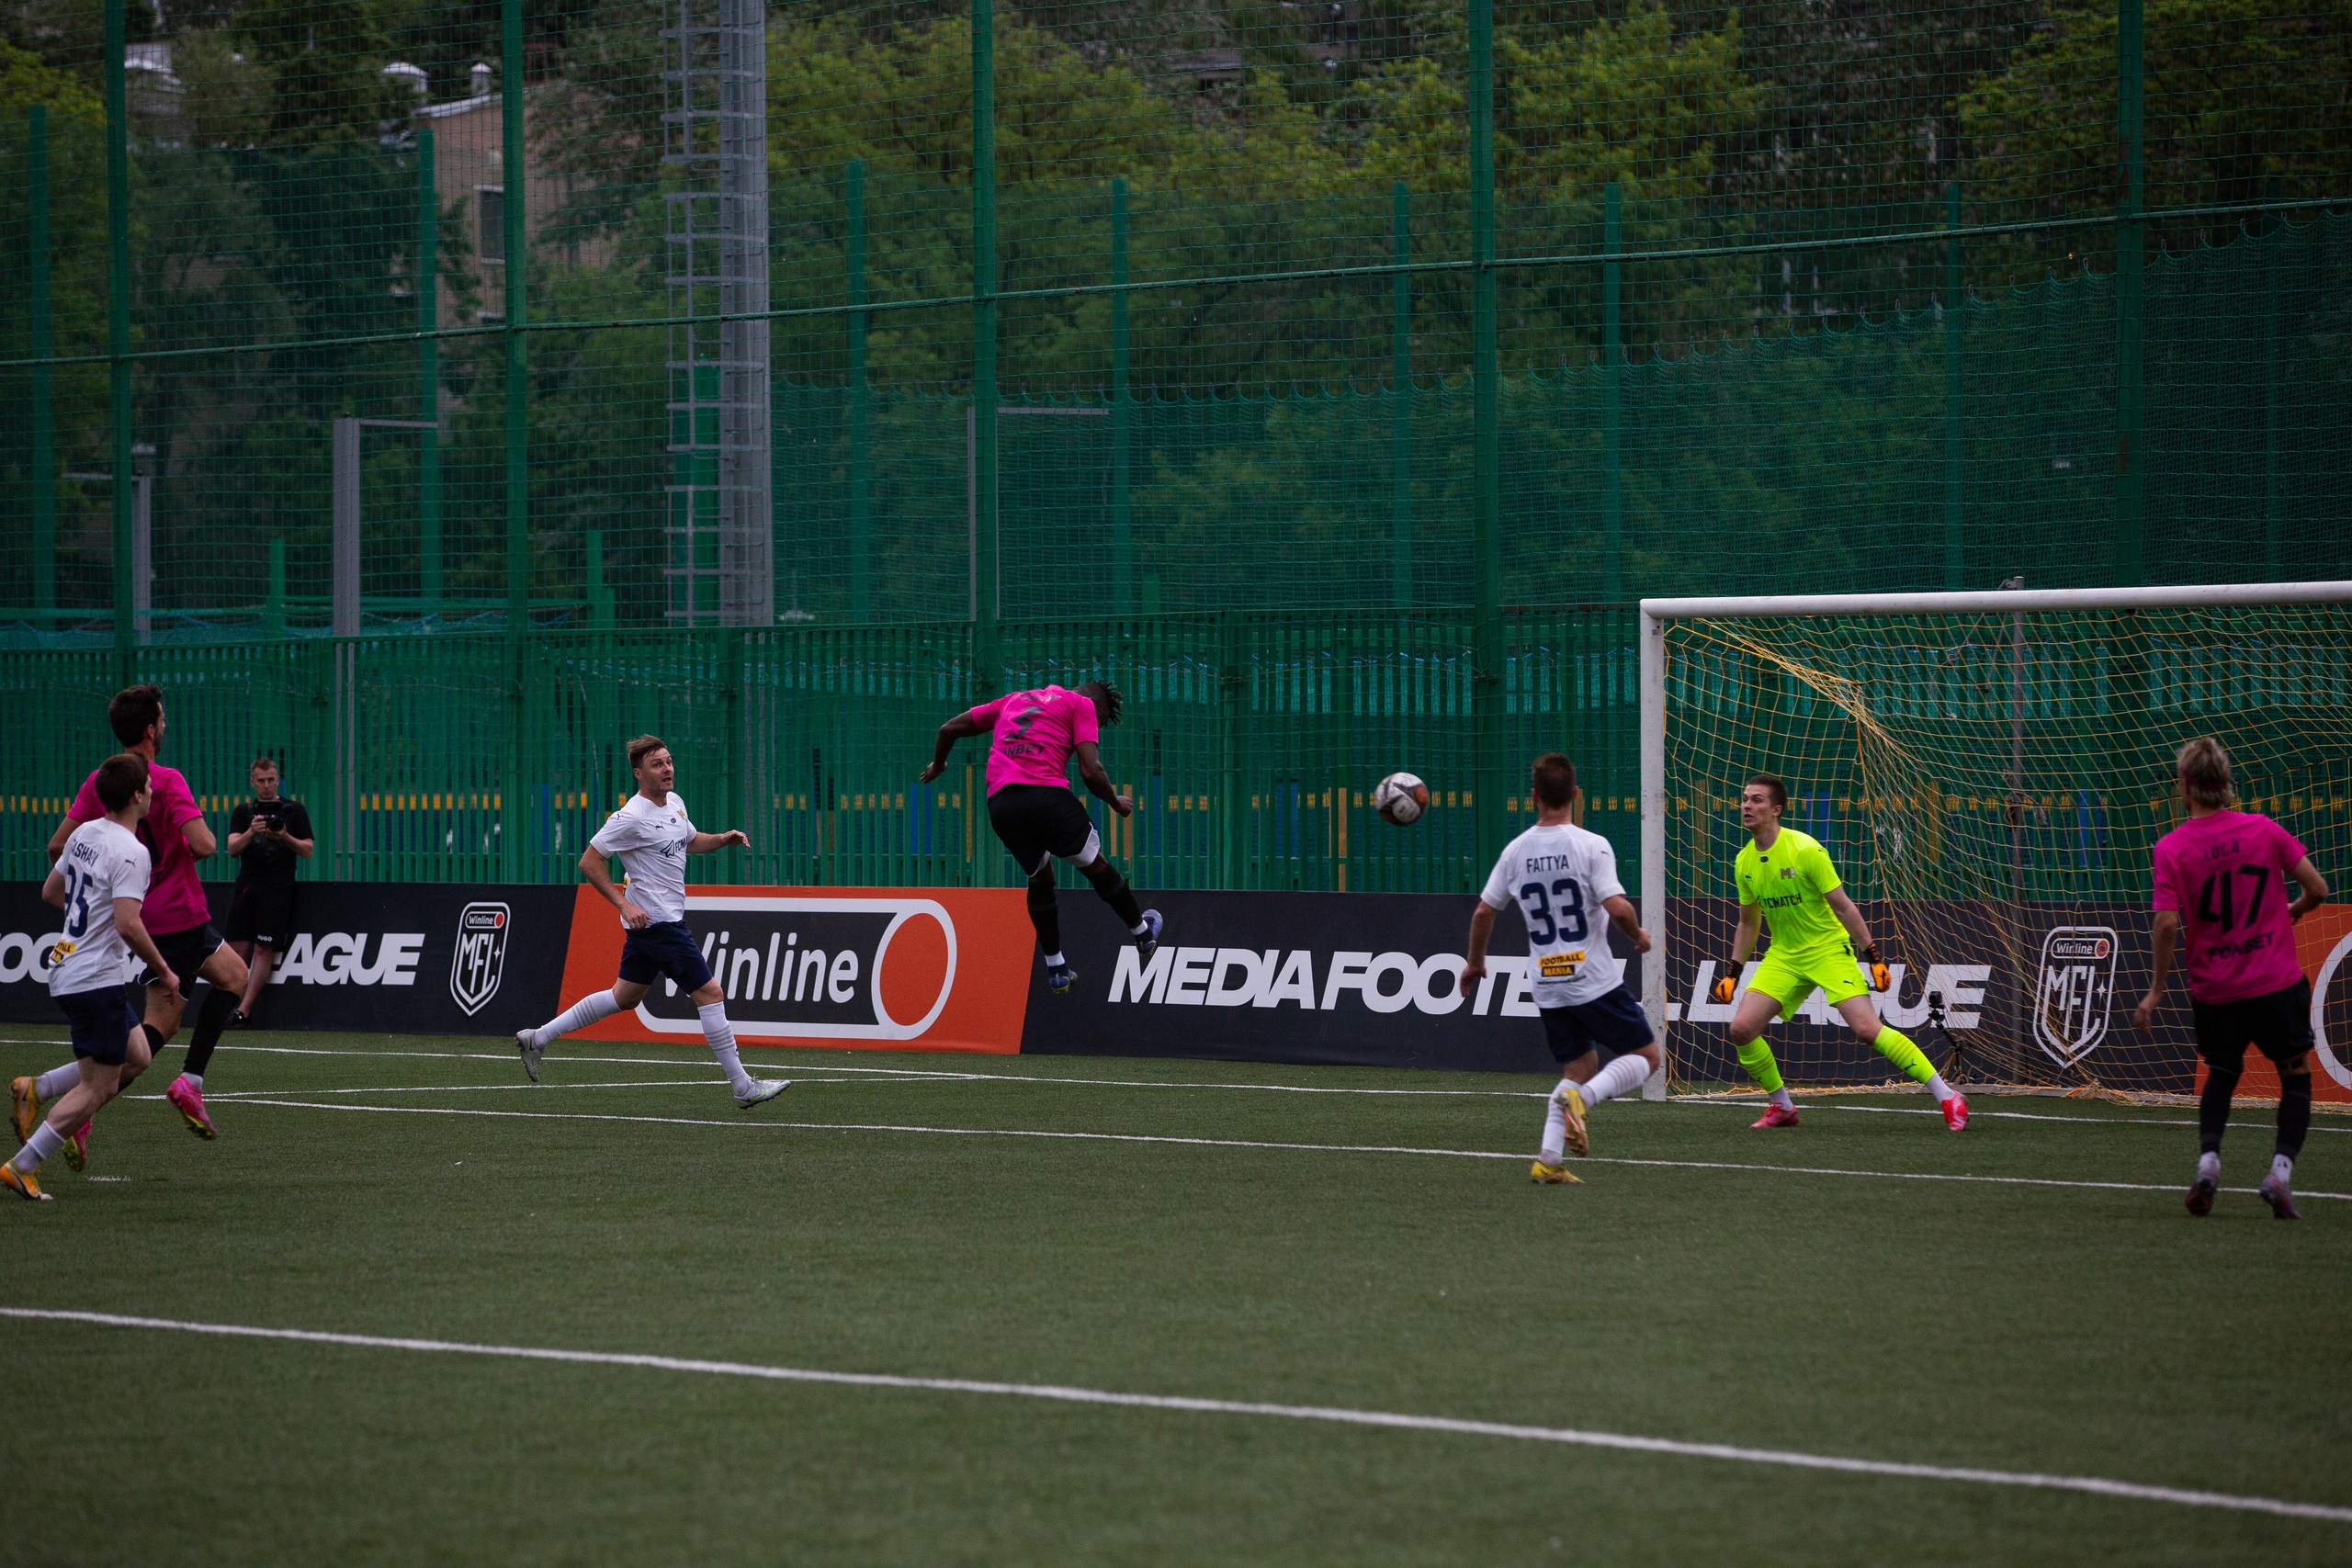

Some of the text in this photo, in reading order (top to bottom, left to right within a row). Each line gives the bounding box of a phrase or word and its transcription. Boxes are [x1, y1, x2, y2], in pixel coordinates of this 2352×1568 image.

[1526, 854, 1569, 874] FATTYA
[1521, 878, 1589, 946] 33
[2197, 863, 2269, 936] 47
[469, 915, 494, 925] Winline
[257, 934, 273, 942] HUGO
[2208, 931, 2275, 963] FONBET
[196, 932, 425, 986] AGUE
[1540, 953, 1581, 965] FOOTBALL
[1544, 966, 1574, 976] MANIA
[1108, 946, 1316, 1010] MEDIA
